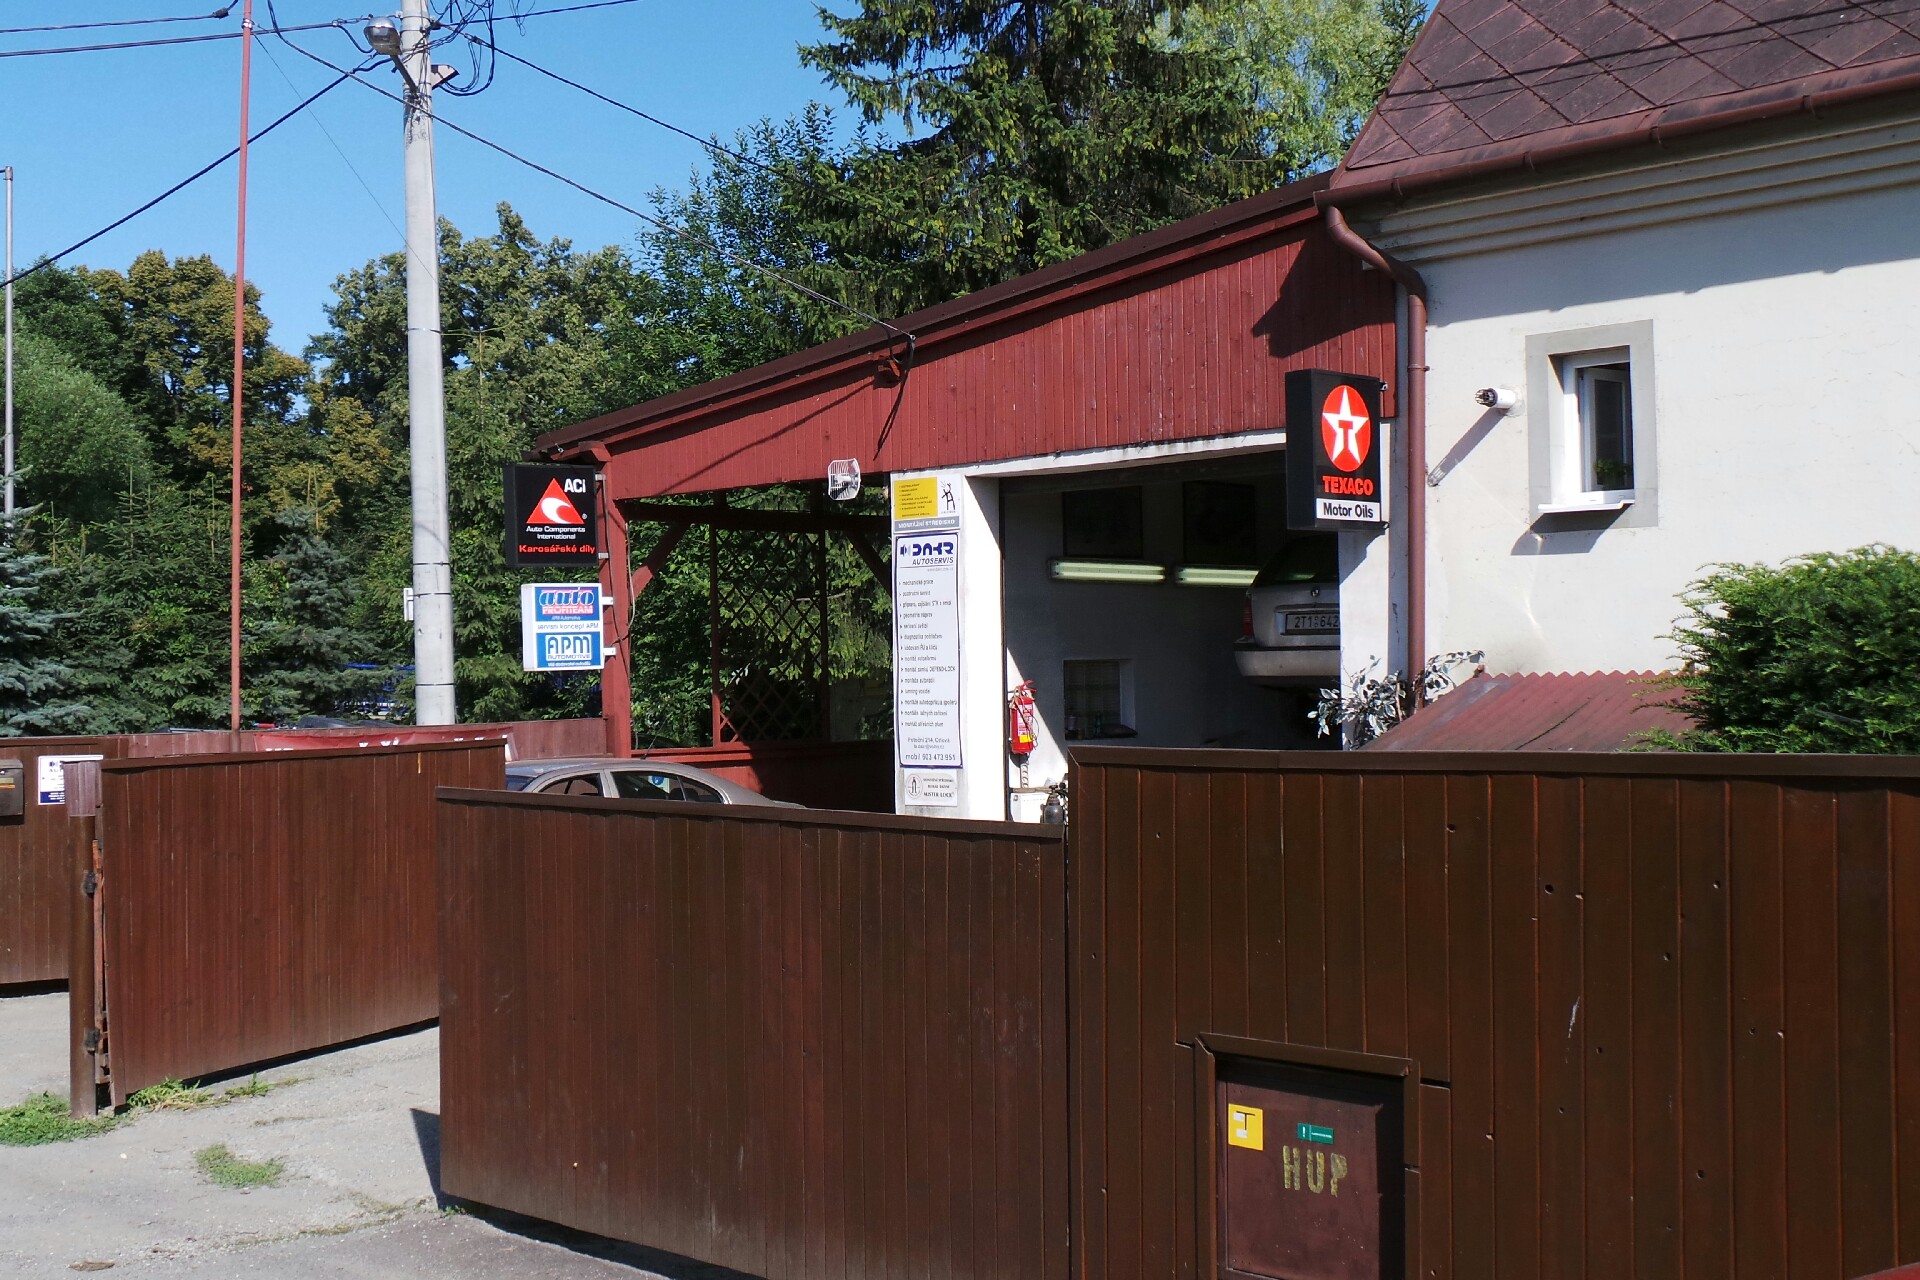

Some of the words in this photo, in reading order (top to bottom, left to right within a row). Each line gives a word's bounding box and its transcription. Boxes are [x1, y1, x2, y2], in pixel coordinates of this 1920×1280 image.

[1322, 475, 1374, 496] TEXACO
[1323, 502, 1352, 517] Motor
[1354, 504, 1374, 518] Oils
[526, 525, 543, 533] Auto
[544, 525, 586, 534] Components
[519, 544, 577, 553] Karosářské
[579, 544, 595, 554] díly
[912, 557, 954, 566] AUTOSERVIS
[539, 587, 595, 607] auto
[542, 606, 594, 615] PROFITEAM
[548, 635, 590, 655] APM
[1282, 1145, 1348, 1198] HUP
